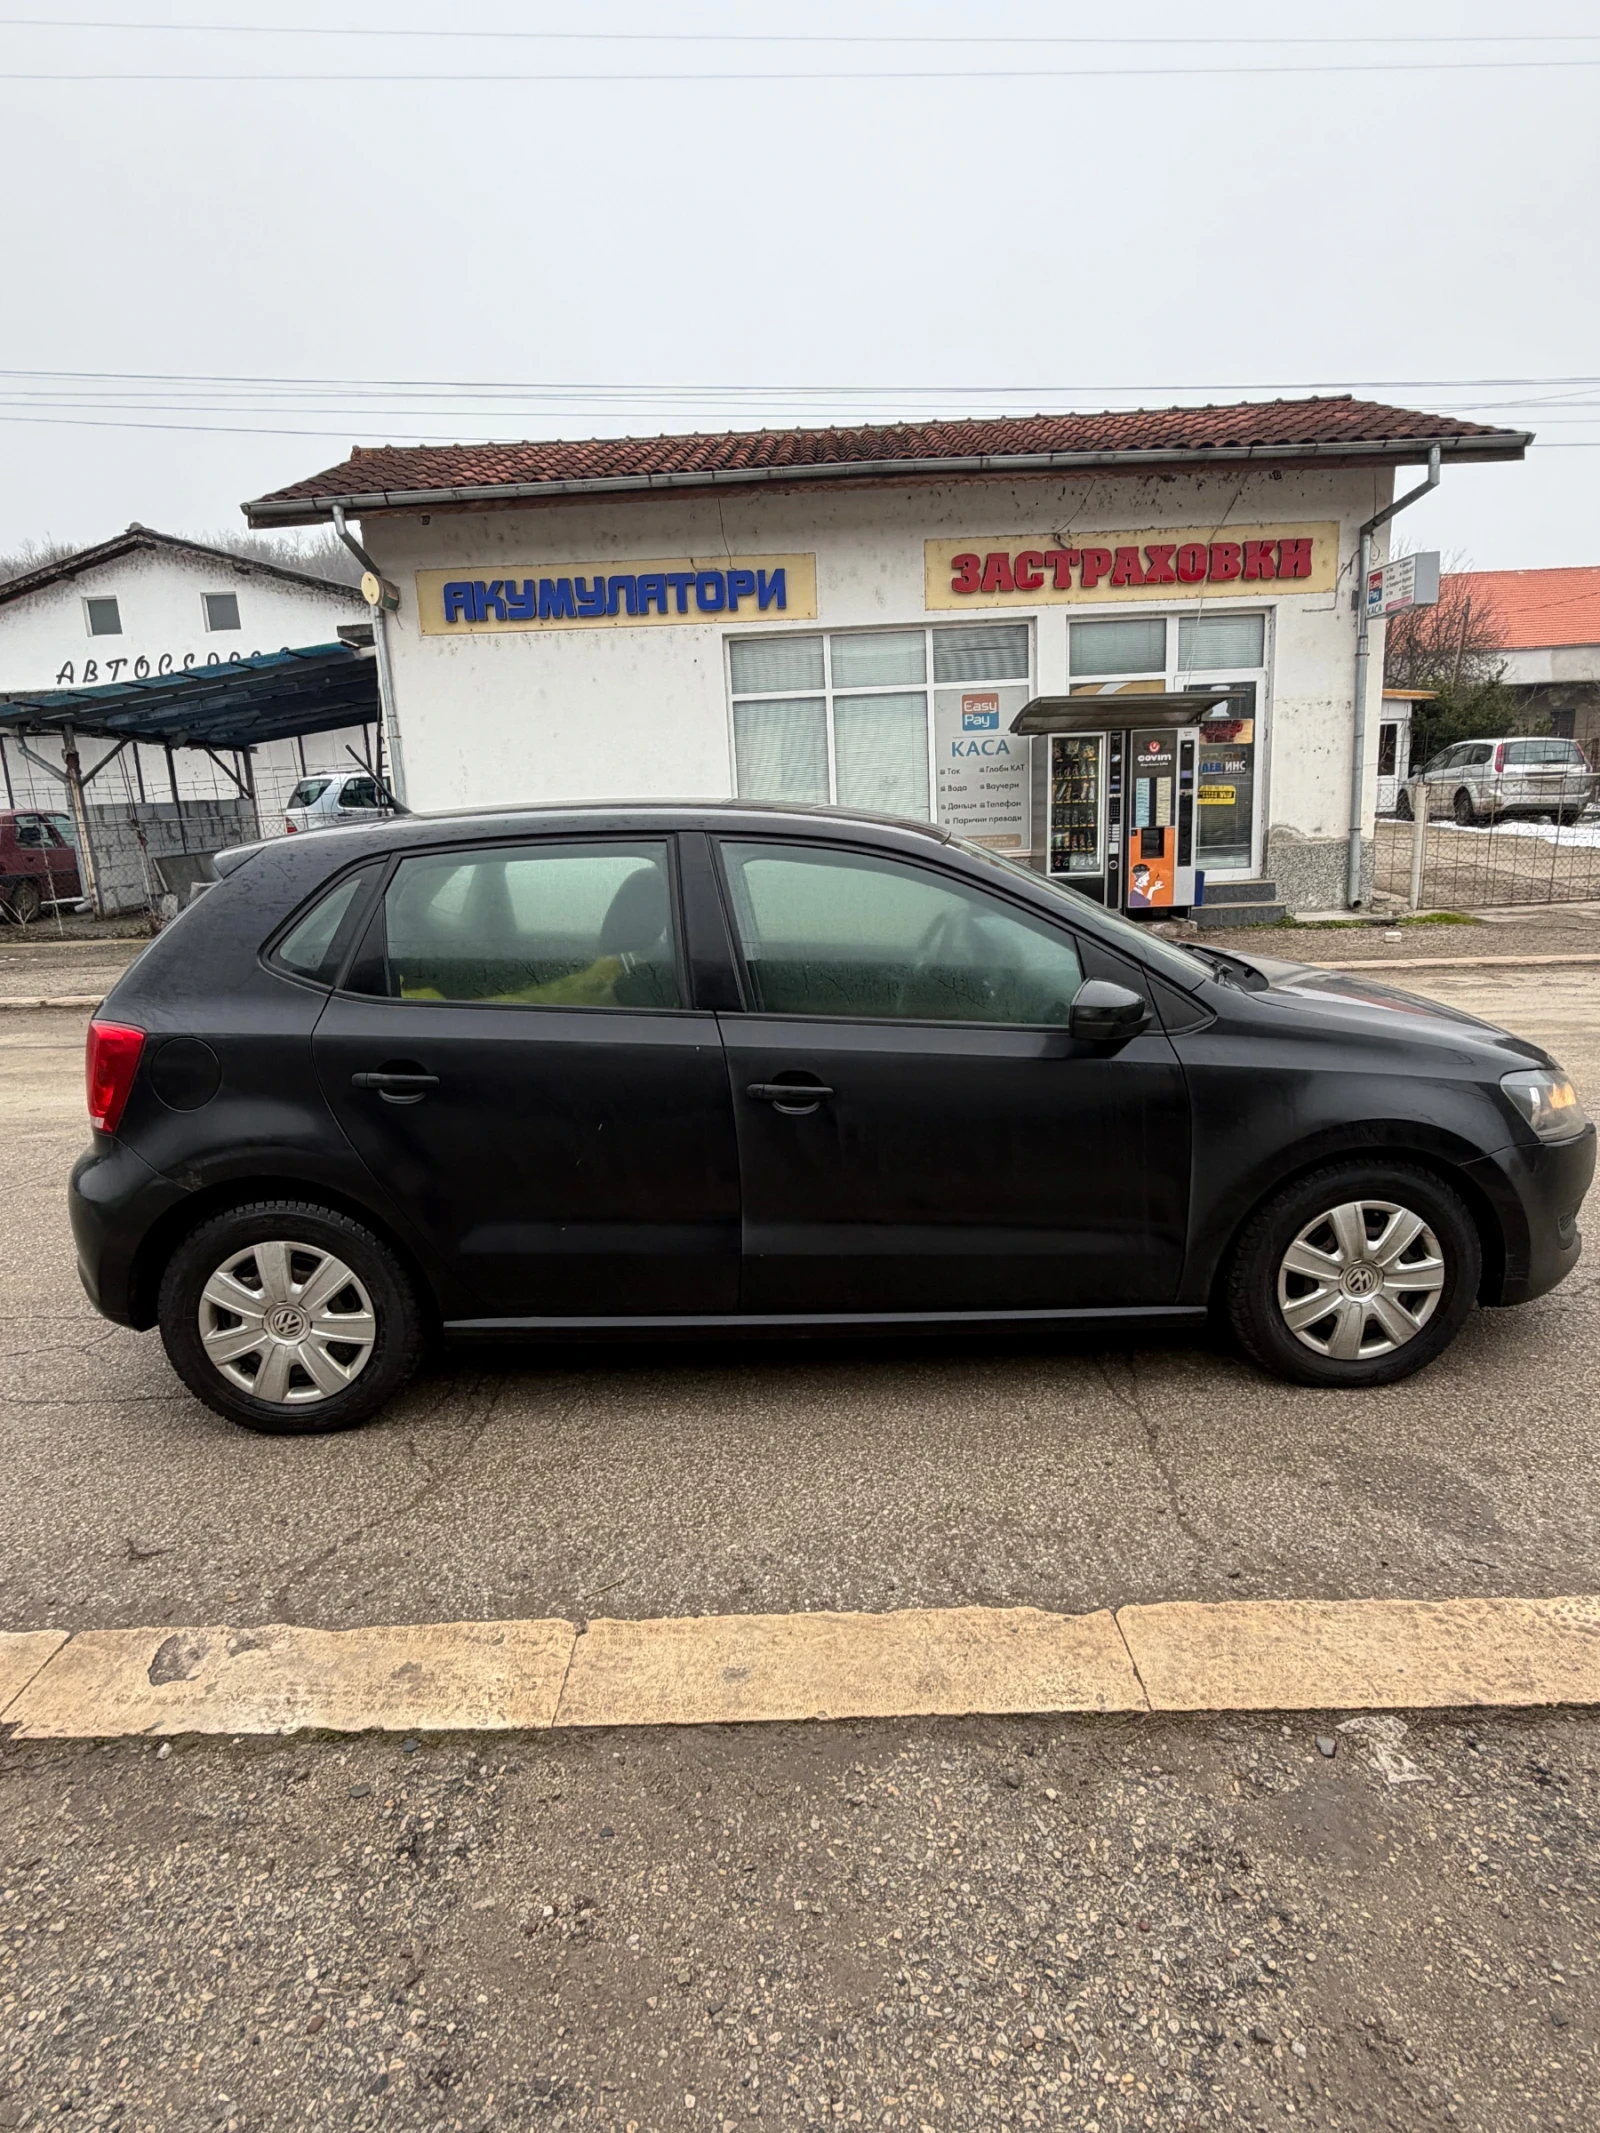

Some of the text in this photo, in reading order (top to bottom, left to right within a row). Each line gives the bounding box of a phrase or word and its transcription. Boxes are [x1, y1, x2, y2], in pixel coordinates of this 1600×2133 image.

[950, 537, 1314, 594] ЗАСТРАХОВКИ
[443, 568, 787, 623] АКУМУЛАТОРИ
[964, 700, 997, 713] Easy
[964, 714, 990, 728] Pay
[951, 739, 1010, 757] КАСА
[1137, 753, 1172, 762] covim
[947, 767, 961, 775] Ток
[985, 763, 1025, 773] Глоби КАТ
[1225, 760, 1246, 772] ИНС
[947, 784, 968, 792] Вода
[985, 783, 1019, 792] Ваучери
[986, 799, 1022, 809] Телефон
[952, 815, 1022, 826] Парични преводи
